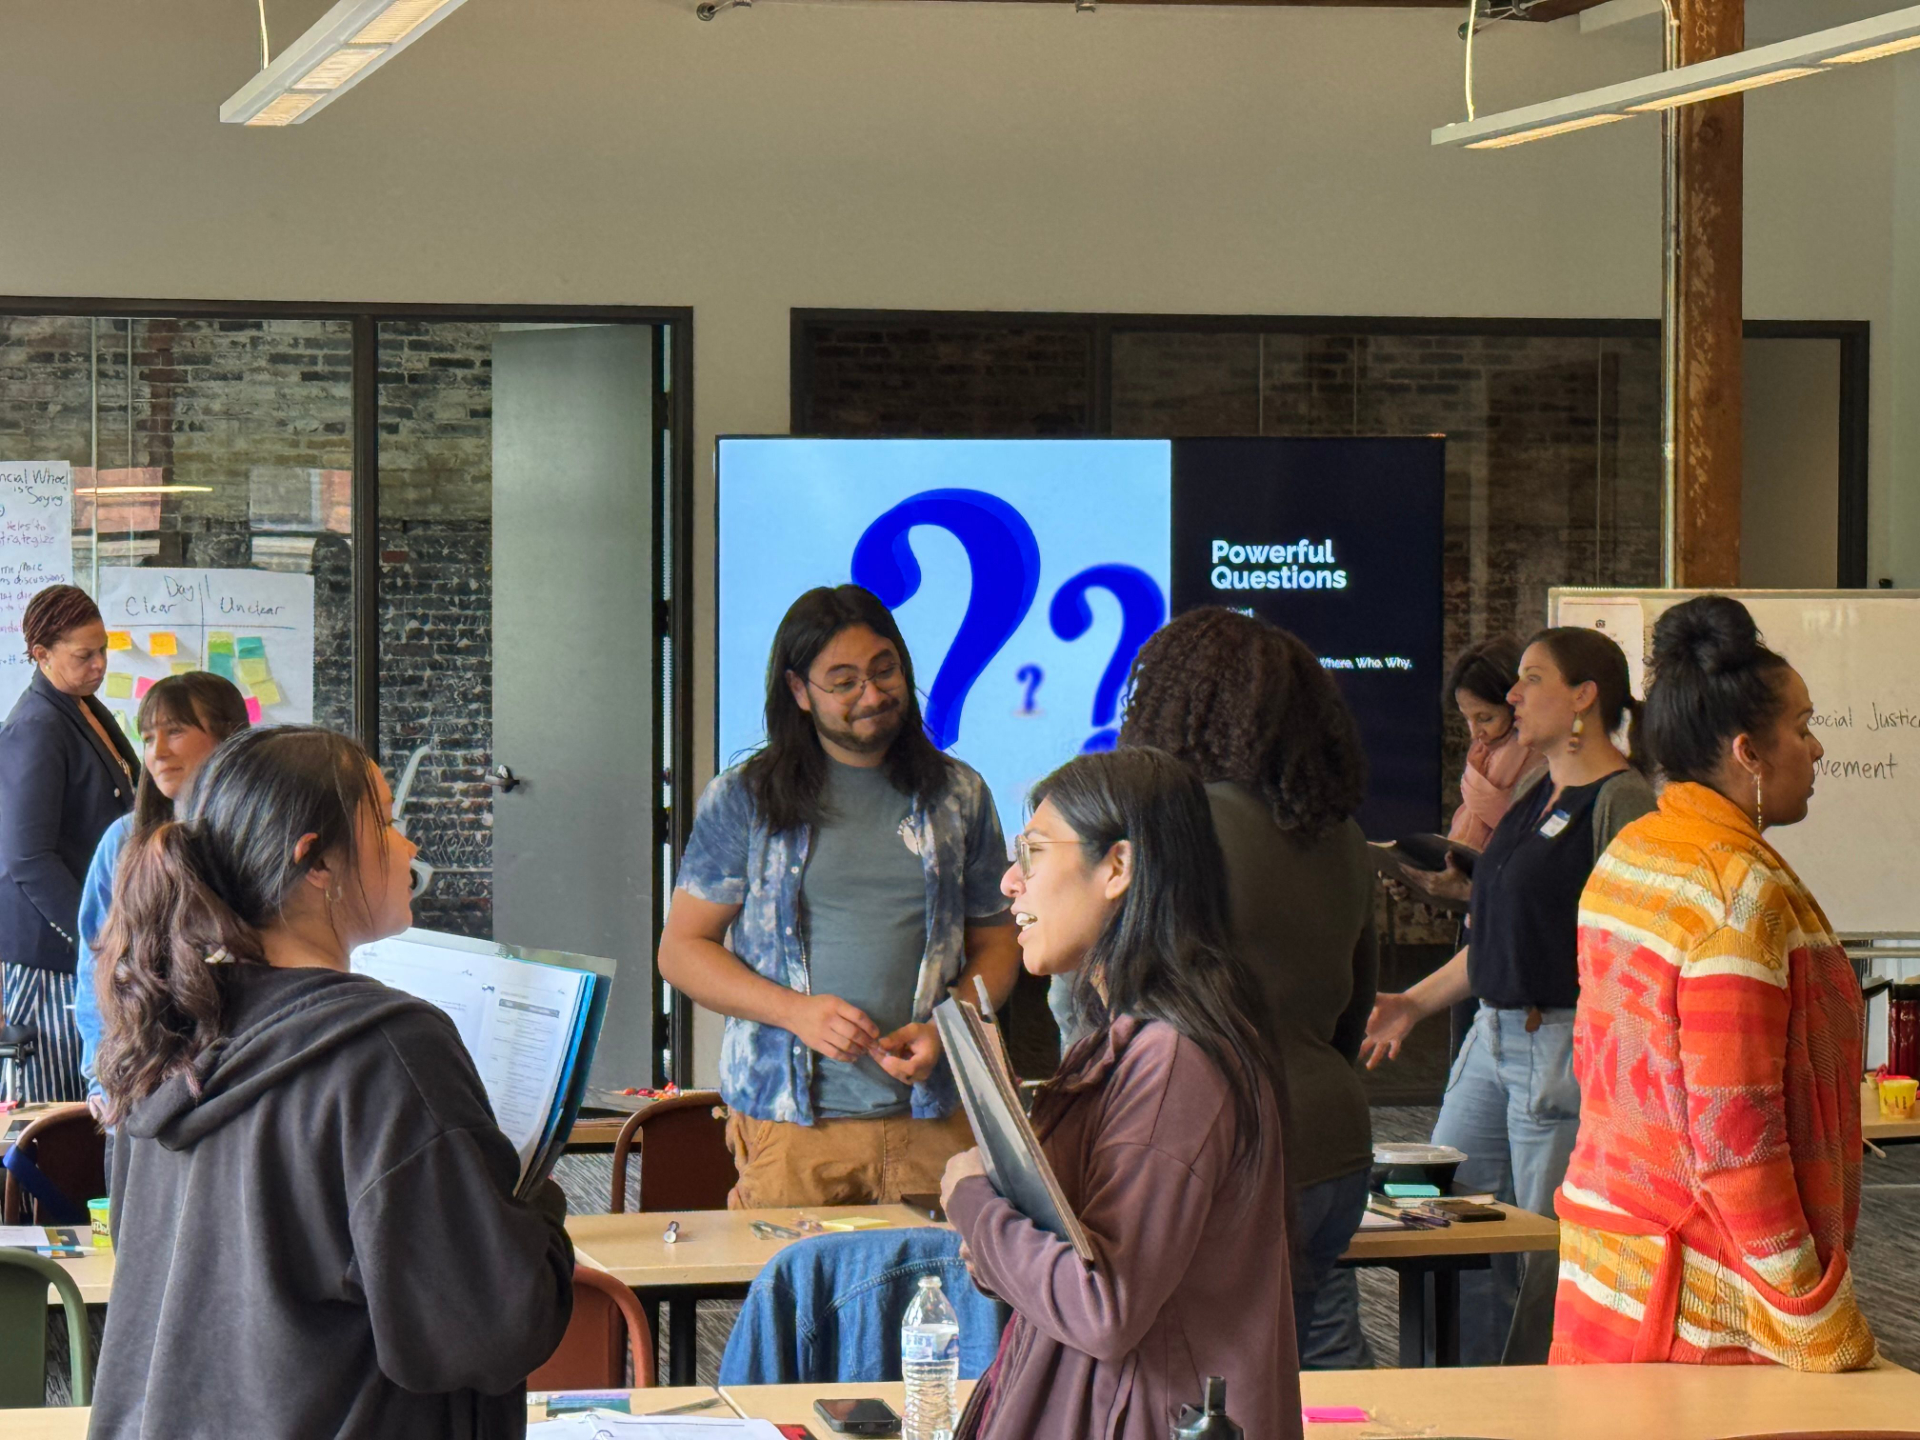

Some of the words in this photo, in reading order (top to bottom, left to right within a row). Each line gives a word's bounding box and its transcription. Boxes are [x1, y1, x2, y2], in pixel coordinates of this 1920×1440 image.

[1211, 539, 1335, 564] Powerful
[164, 575, 194, 602] Day
[1211, 565, 1348, 589] Questions
[126, 596, 177, 616] Clear
[220, 596, 285, 617] Unclear
[1867, 702, 1920, 731] Justic
[1814, 753, 1898, 779] vement
